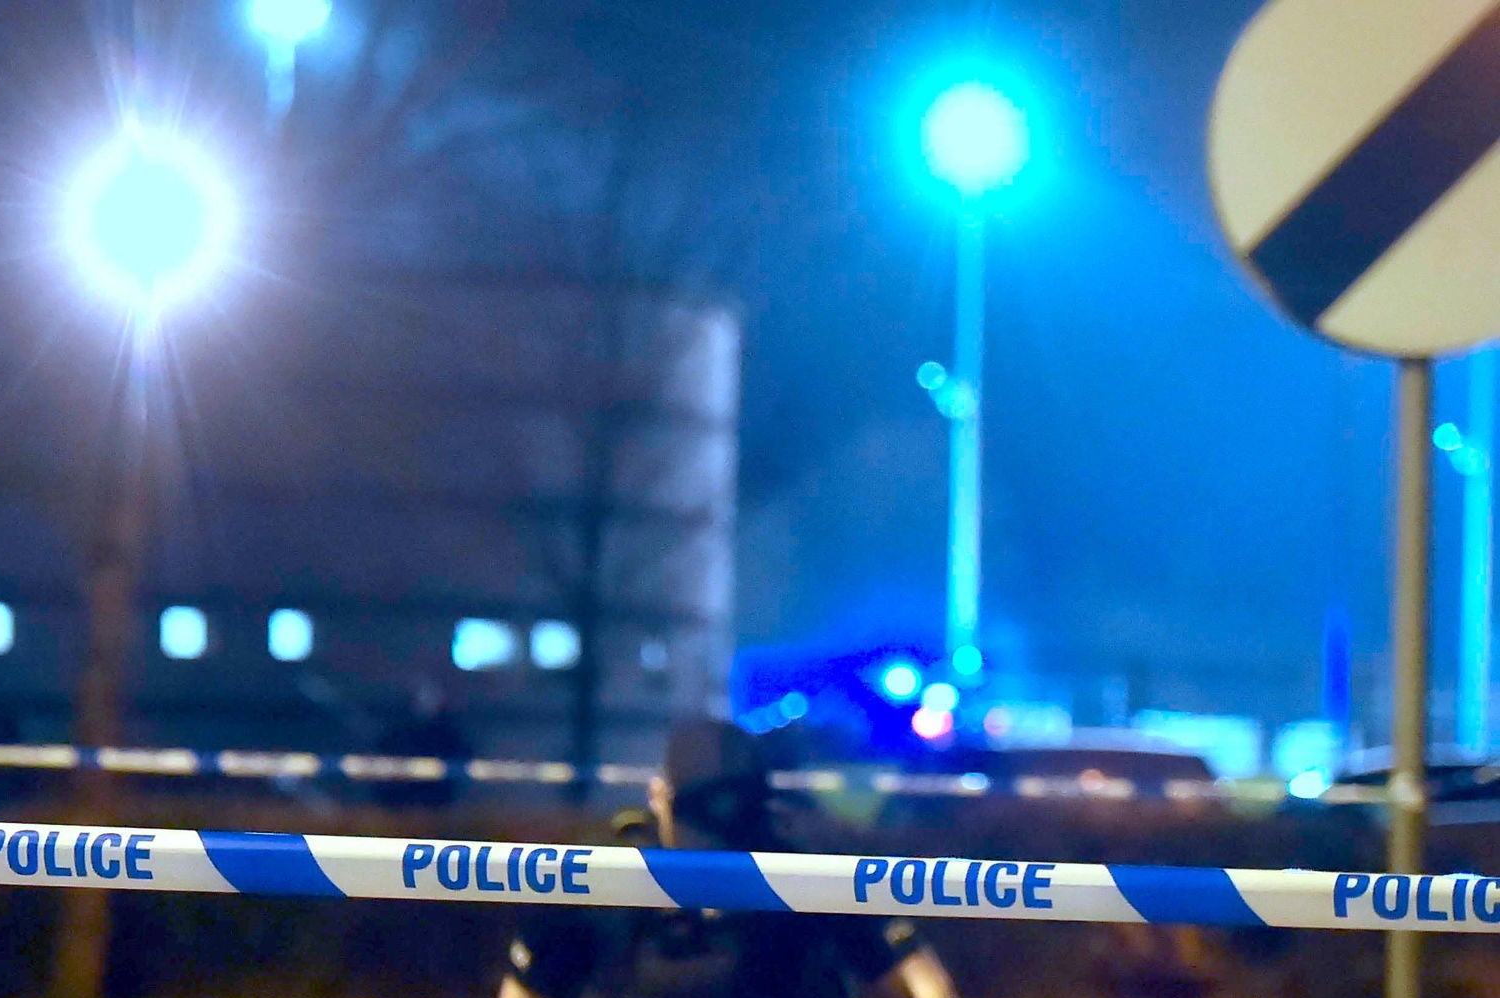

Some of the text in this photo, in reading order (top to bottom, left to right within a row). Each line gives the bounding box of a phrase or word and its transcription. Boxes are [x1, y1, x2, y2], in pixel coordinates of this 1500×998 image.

[401, 842, 593, 895] POLICE
[853, 857, 1056, 910] POLICE
[1333, 872, 1500, 925] POLIC
